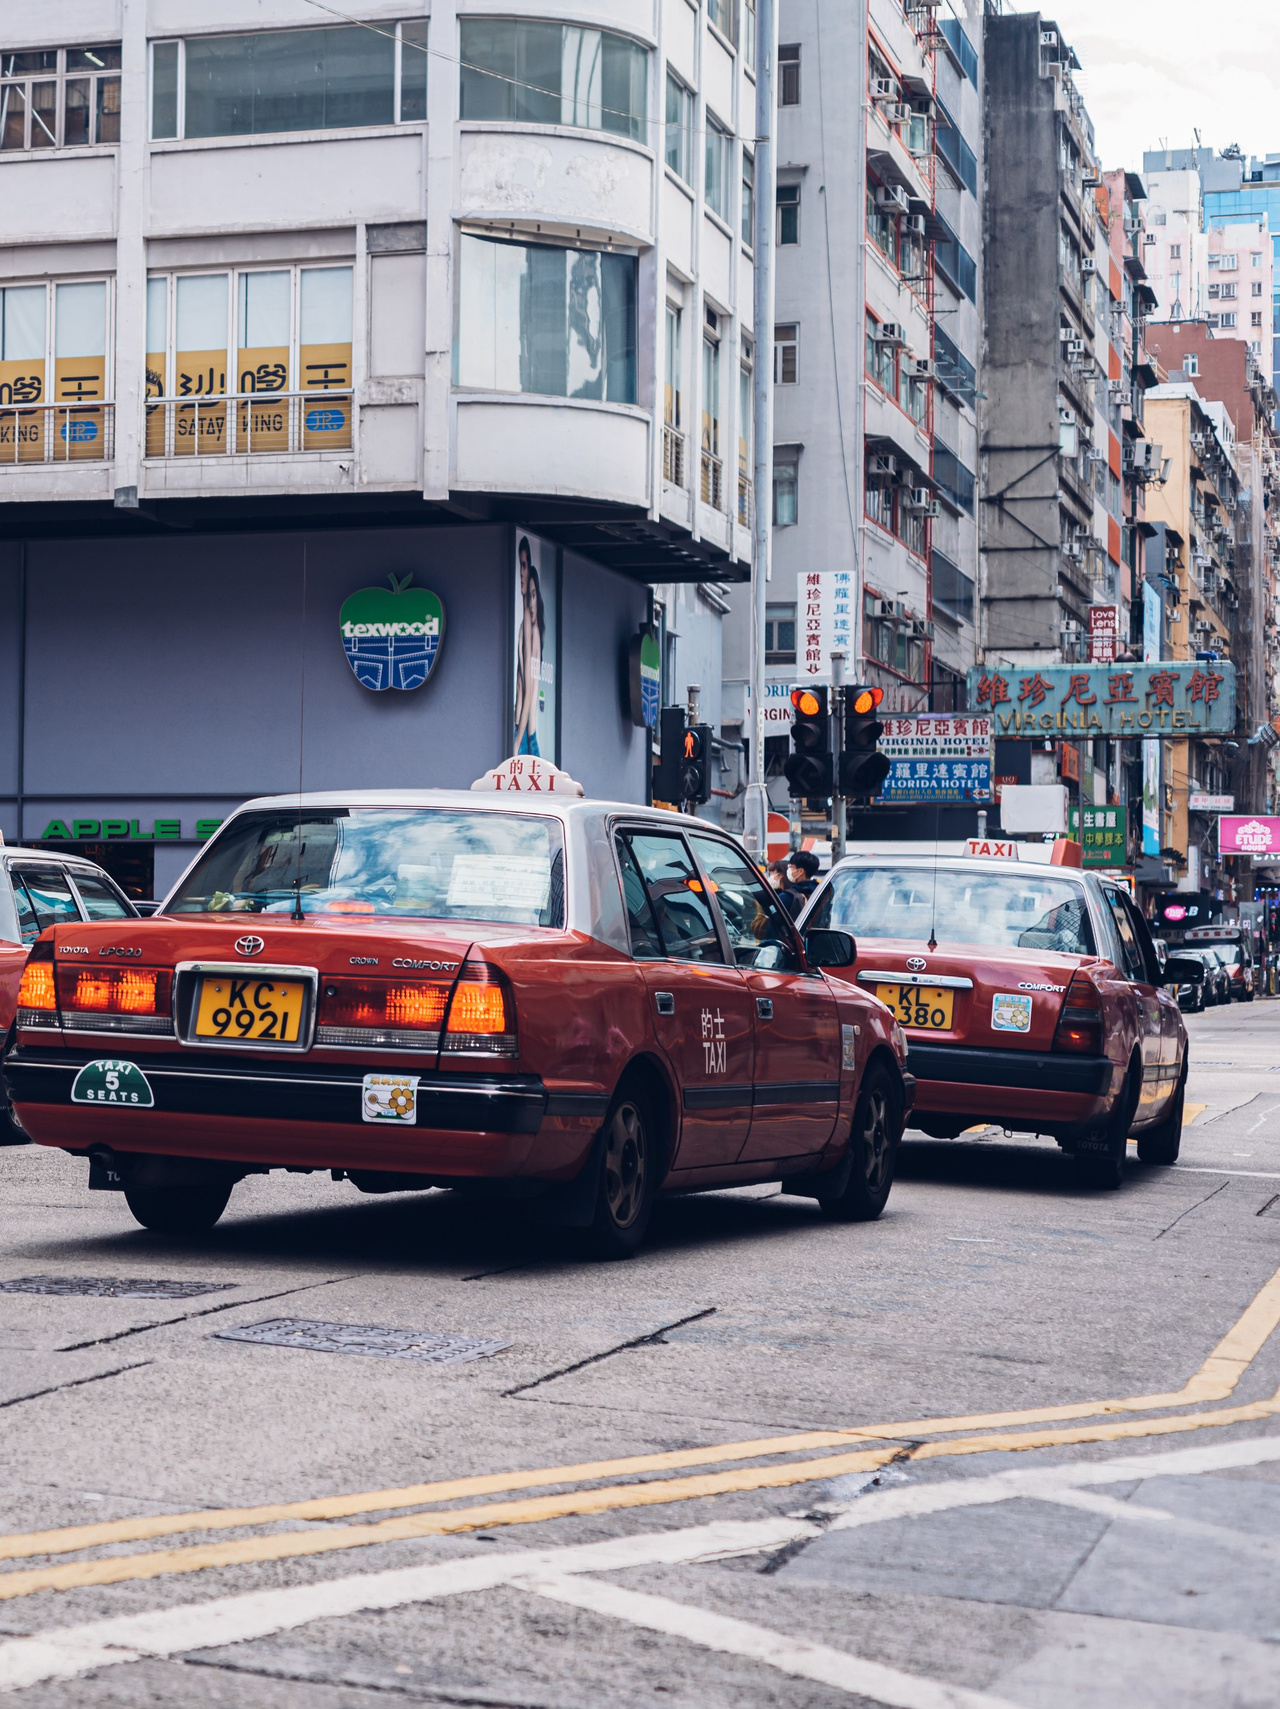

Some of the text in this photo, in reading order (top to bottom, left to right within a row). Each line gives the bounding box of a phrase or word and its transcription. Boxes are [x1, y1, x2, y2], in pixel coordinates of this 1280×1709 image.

[0, 425, 39, 443] KING
[178, 417, 225, 441] SATAY
[806, 573, 821, 661] 維珍尼亞賓館
[1091, 610, 1115, 619] Love
[341, 617, 439, 637] texwood
[1091, 619, 1115, 628] Lens
[976, 668, 1224, 708] 維珍尼亞賓館
[998, 711, 1201, 730] VIRGINIA HOTEL
[878, 738, 989, 746] VIRGINIA HOTEL
[509, 759, 541, 775] 的士
[492, 775, 556, 791] TAXI
[885, 780, 981, 788] FLORIDA HOTEL
[41, 820, 180, 839] APPLE
[1235, 835, 1273, 845] ETUDE
[968, 841, 1014, 857] TAXI
[59, 946, 89, 954] TOYOTA
[349, 957, 458, 972] CROWN COMFORT
[229, 980, 275, 1009] KC
[1018, 982, 1067, 993] COMFORT
[898, 986, 930, 1008] KL
[212, 1010, 289, 1040] 9921
[701, 1008, 726, 1039] 的士
[703, 1041, 727, 1074] TAXI
[95, 1060, 132, 1075] TAXI
[105, 1071, 119, 1090] 5
[87, 1089, 139, 1102] SEATS
